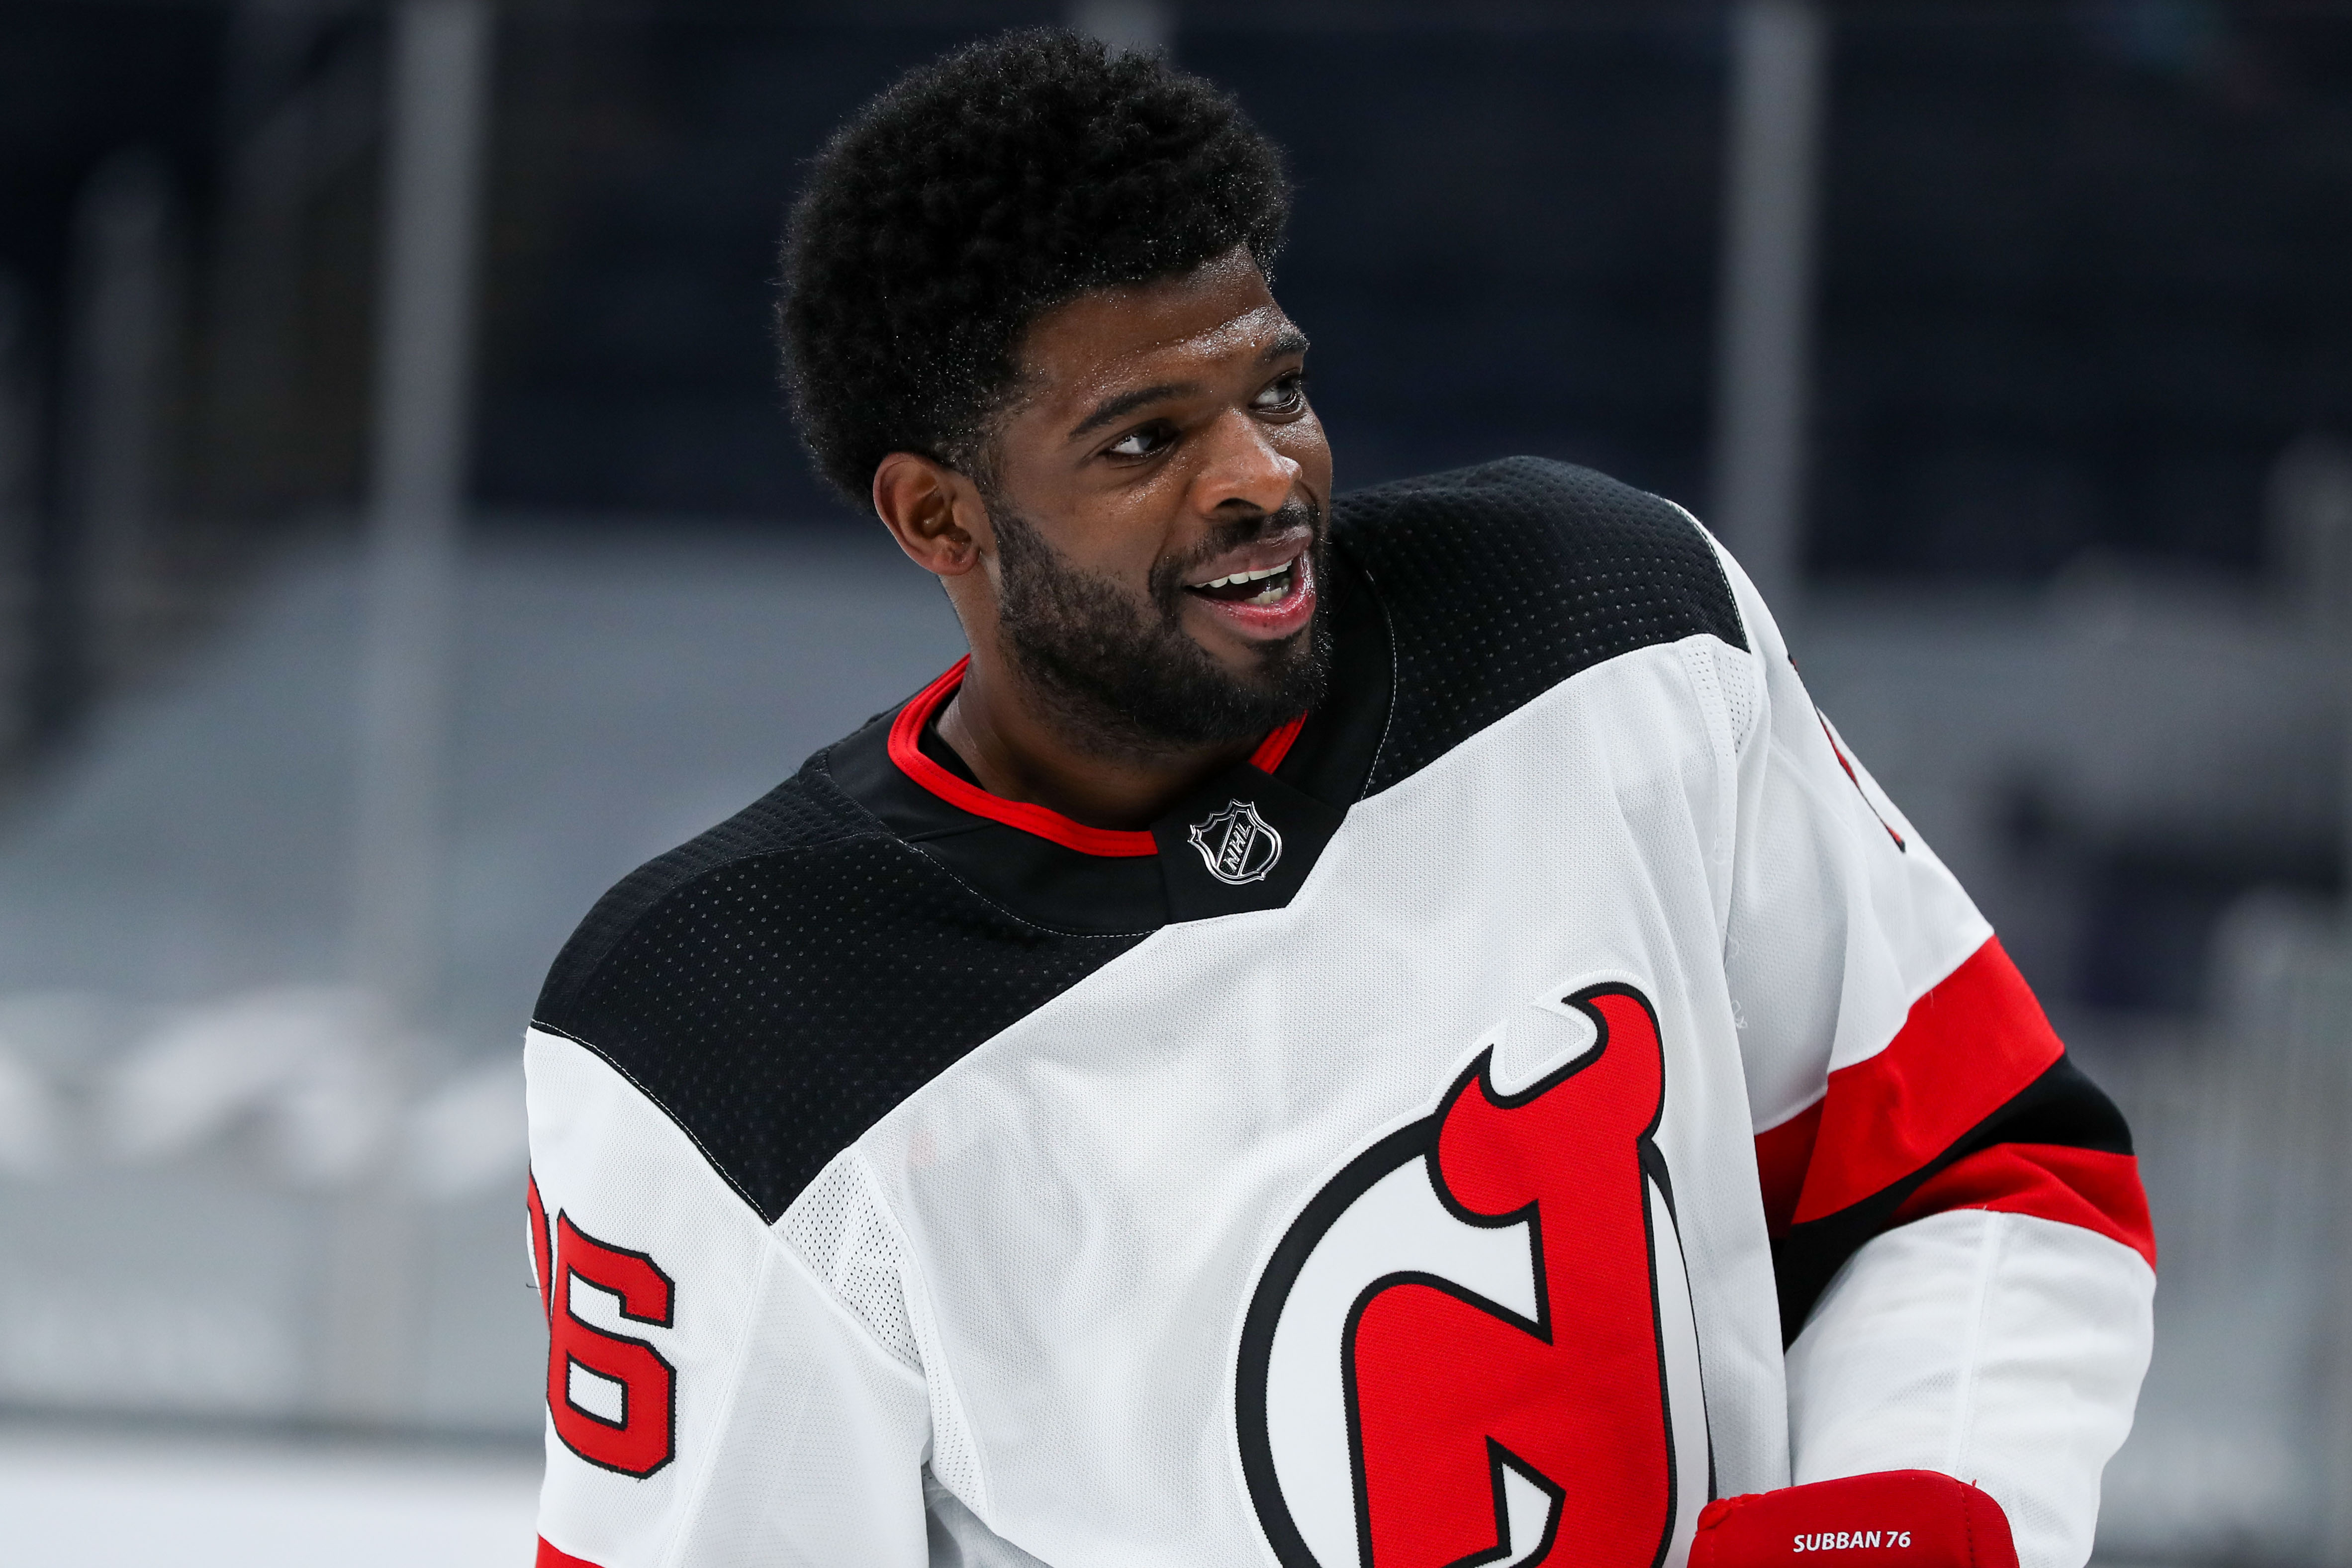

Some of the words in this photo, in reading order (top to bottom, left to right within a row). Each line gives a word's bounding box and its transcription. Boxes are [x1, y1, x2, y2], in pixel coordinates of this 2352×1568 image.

[1223, 822, 1252, 871] NHL
[527, 1159, 676, 1479] 6
[1793, 1531, 1882, 1553] SUBBAN
[1885, 1531, 1911, 1548] 76
